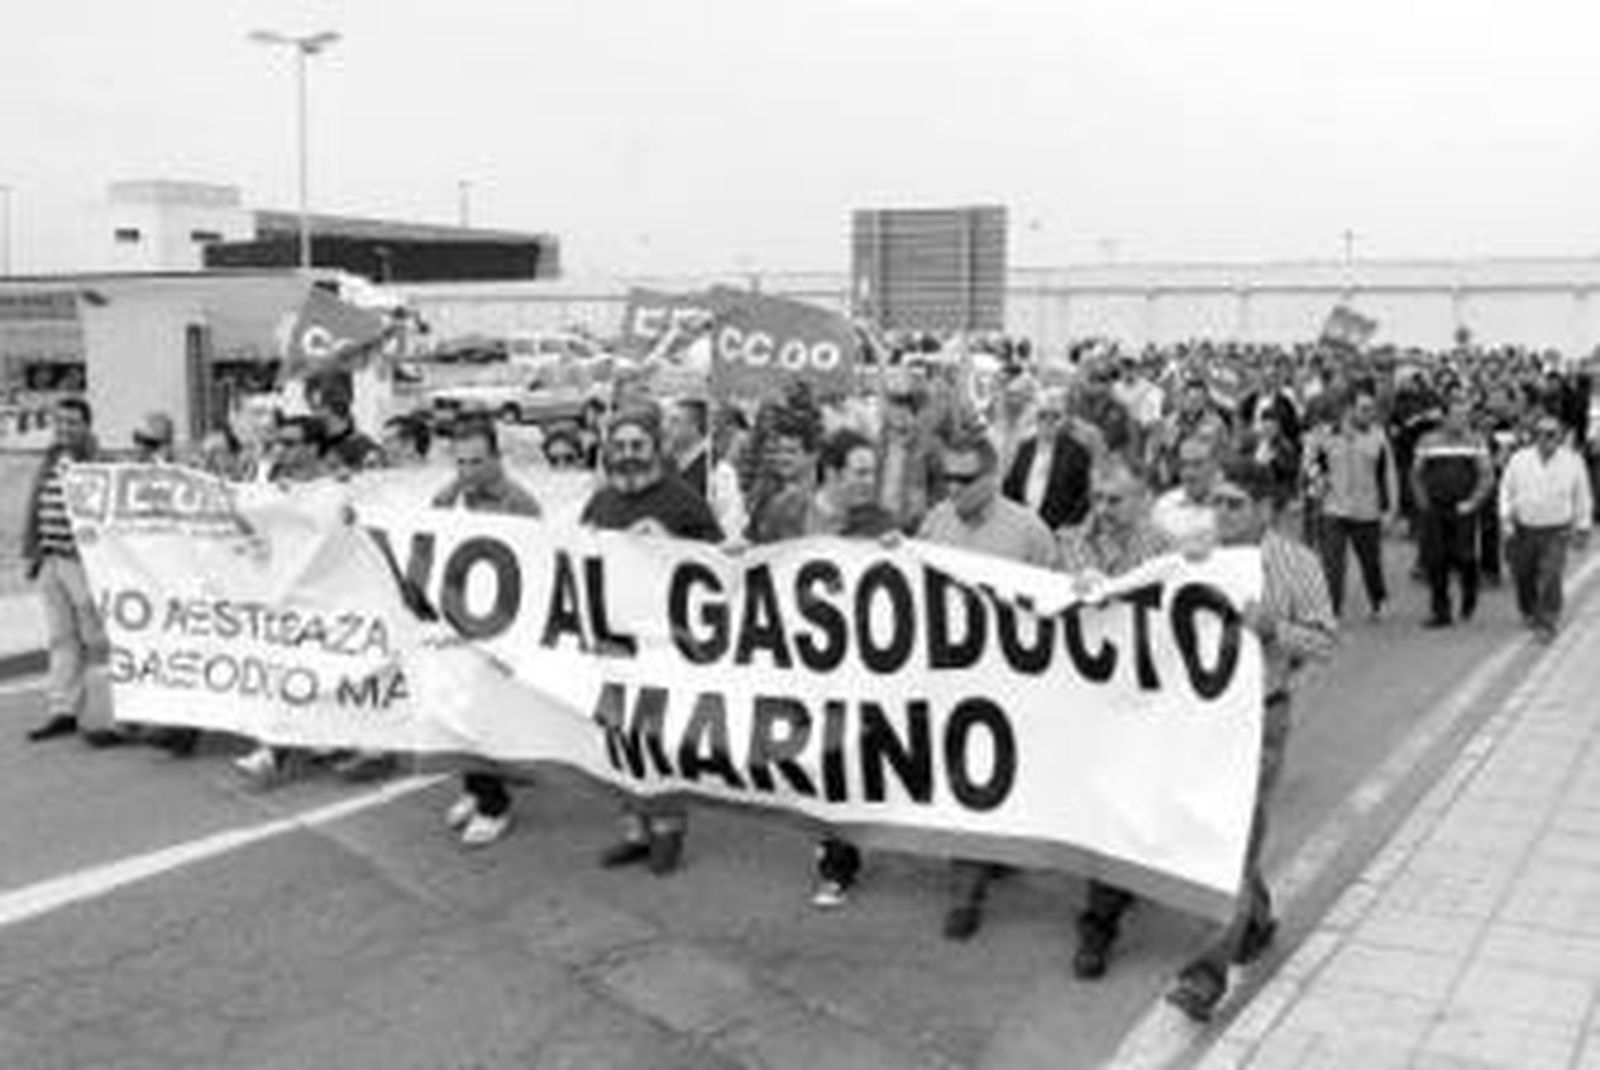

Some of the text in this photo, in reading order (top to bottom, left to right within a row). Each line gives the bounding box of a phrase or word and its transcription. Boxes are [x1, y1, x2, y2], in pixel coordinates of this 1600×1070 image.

[367, 527, 1242, 702] NO AL GASODUCTO
[593, 683, 1018, 812] MARINO
